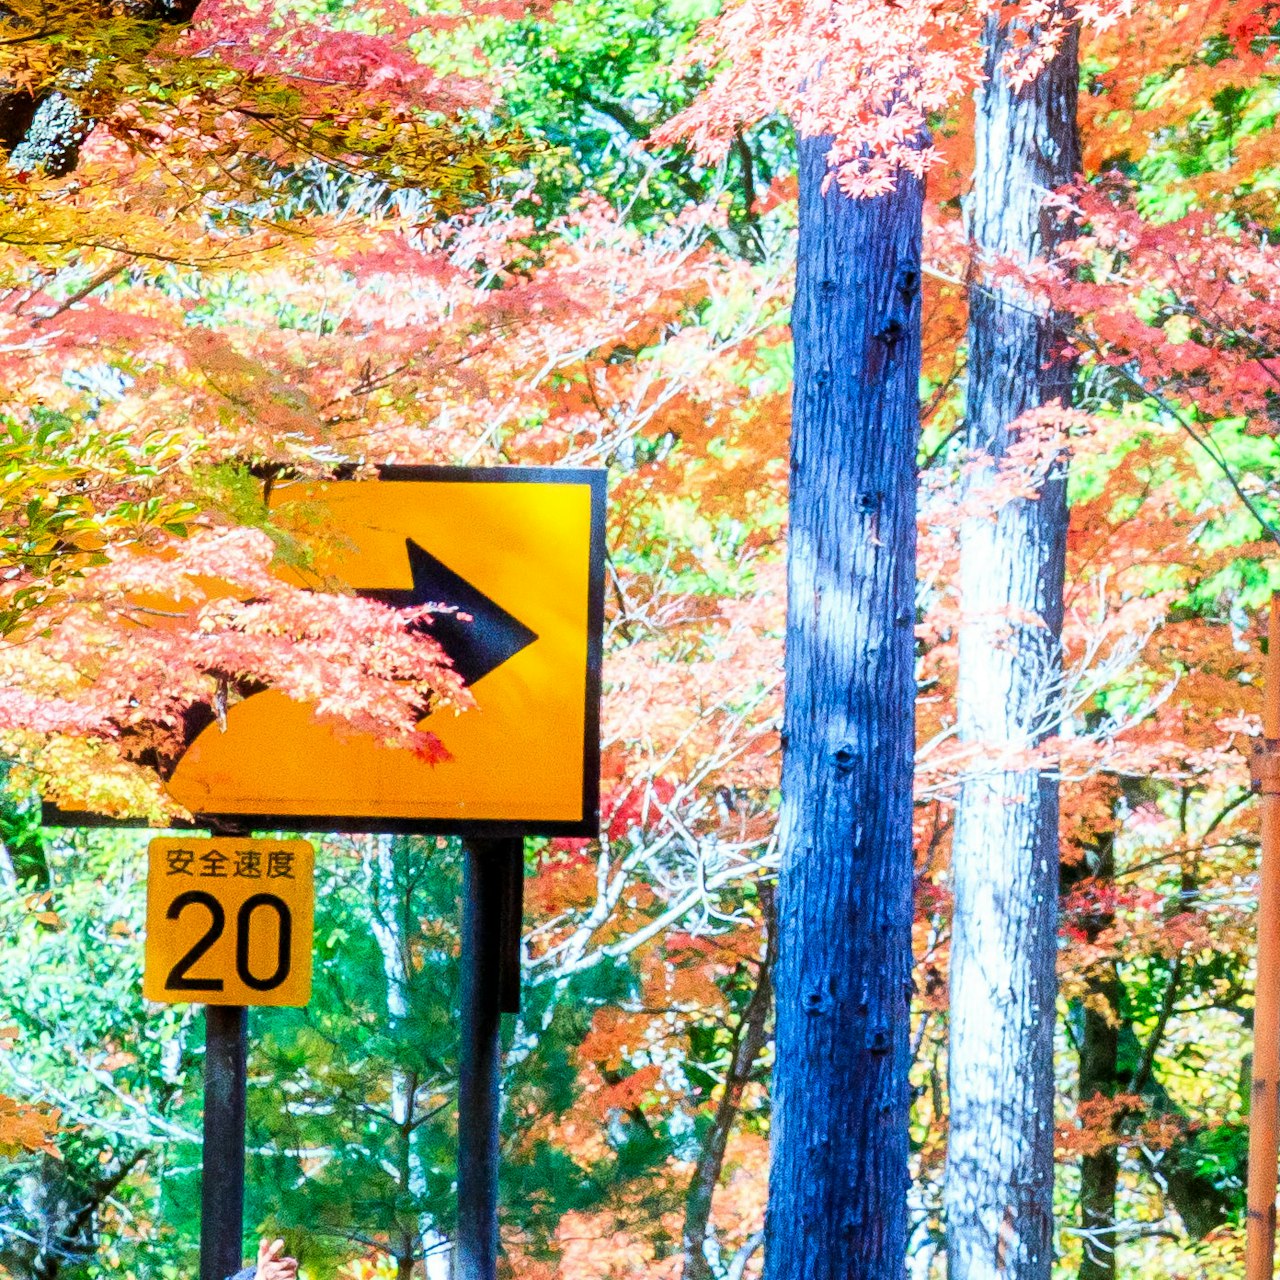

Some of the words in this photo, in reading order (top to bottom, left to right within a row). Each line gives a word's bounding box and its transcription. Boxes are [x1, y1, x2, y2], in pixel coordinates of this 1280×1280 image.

[166, 849, 295, 879] 安全速度
[164, 891, 292, 991] 20
